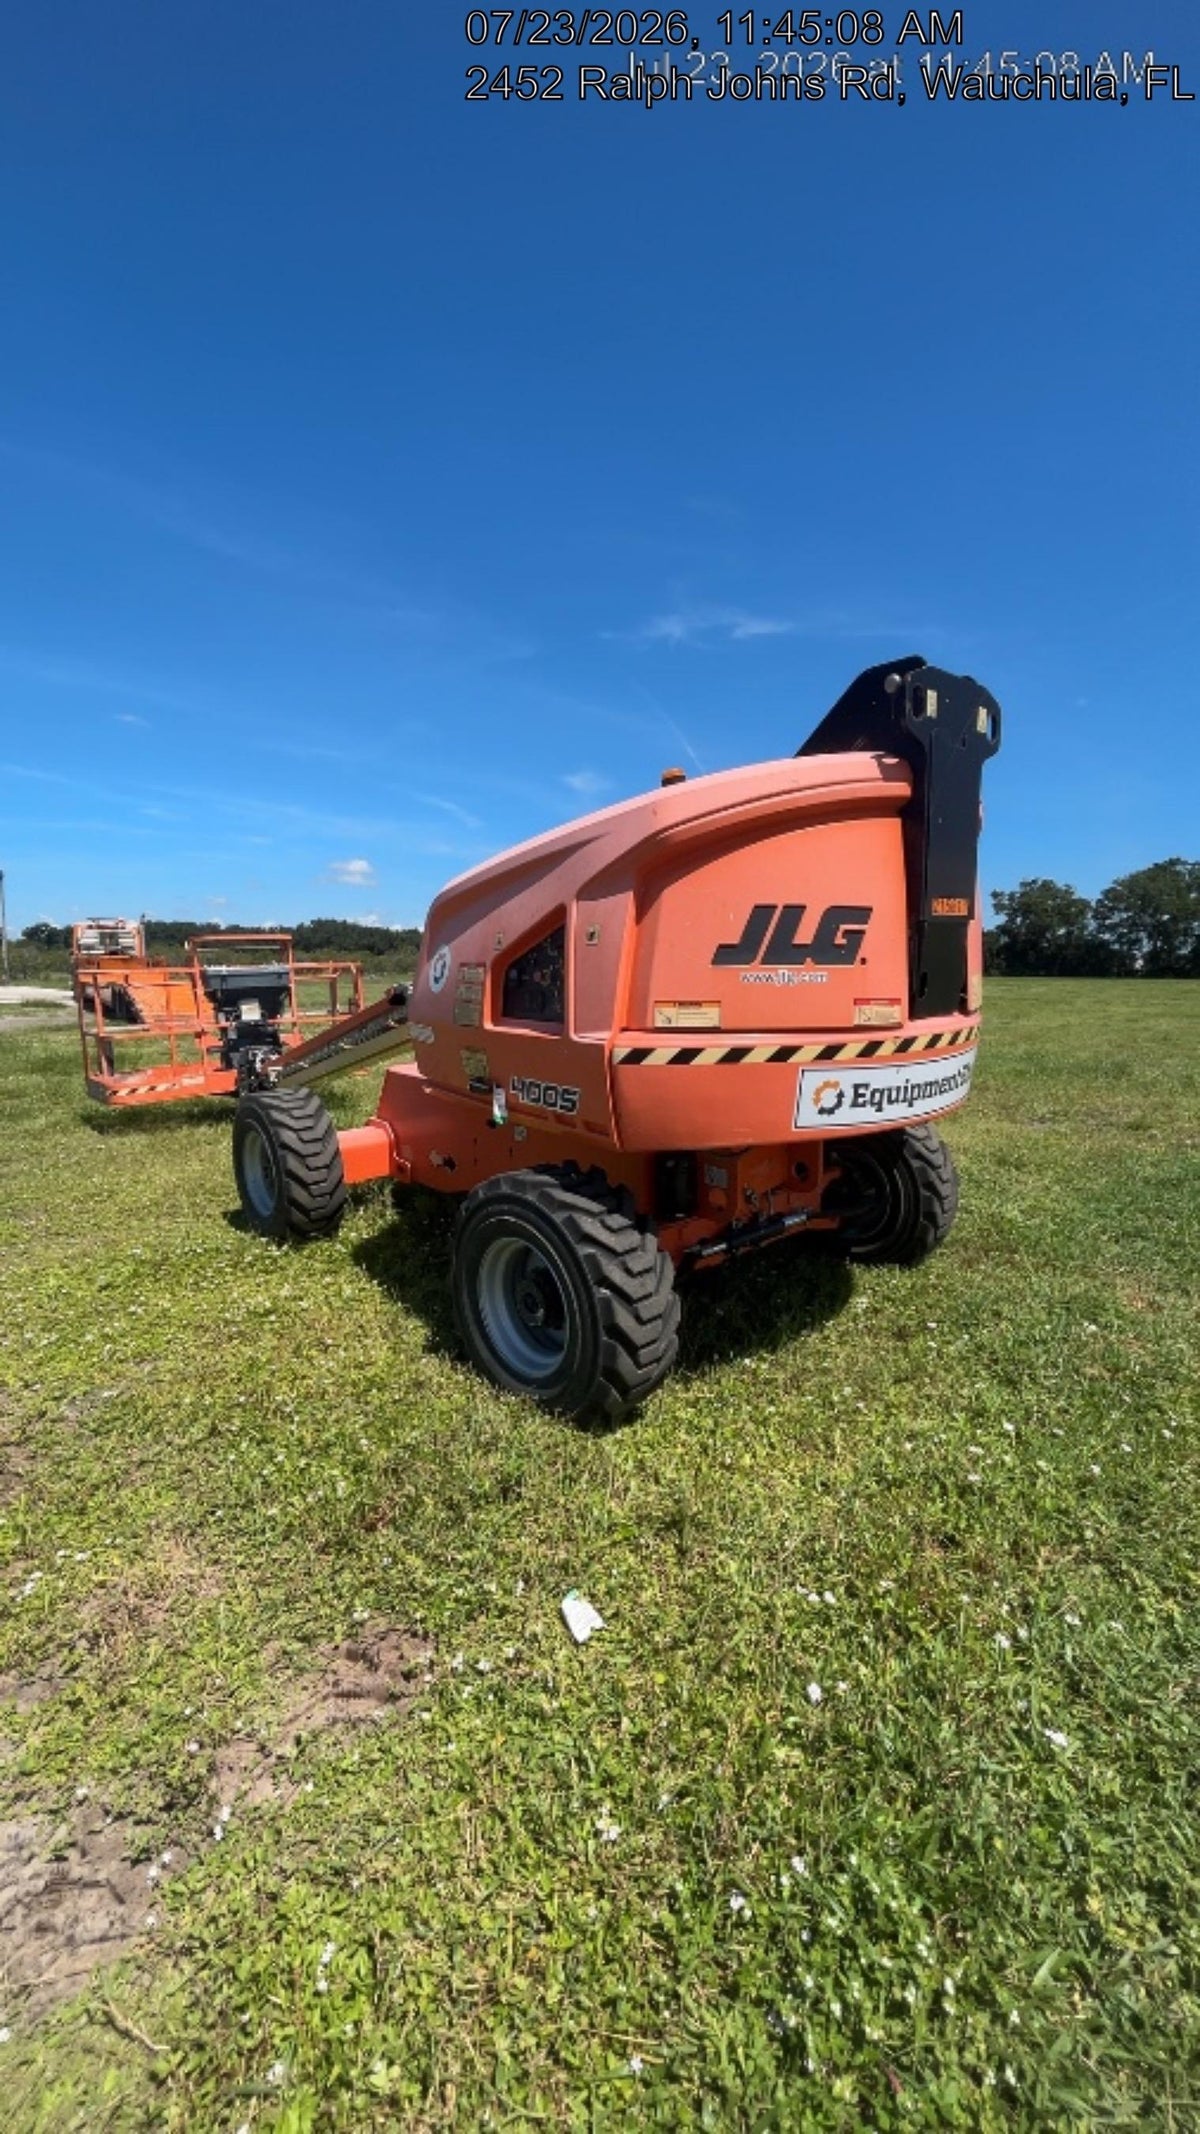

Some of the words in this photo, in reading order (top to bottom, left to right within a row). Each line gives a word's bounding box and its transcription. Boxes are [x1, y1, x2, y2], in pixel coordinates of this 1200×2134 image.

[711, 904, 873, 965] JLG
[741, 969, 829, 987] www.jlg.com
[510, 1076, 580, 1115] 400S
